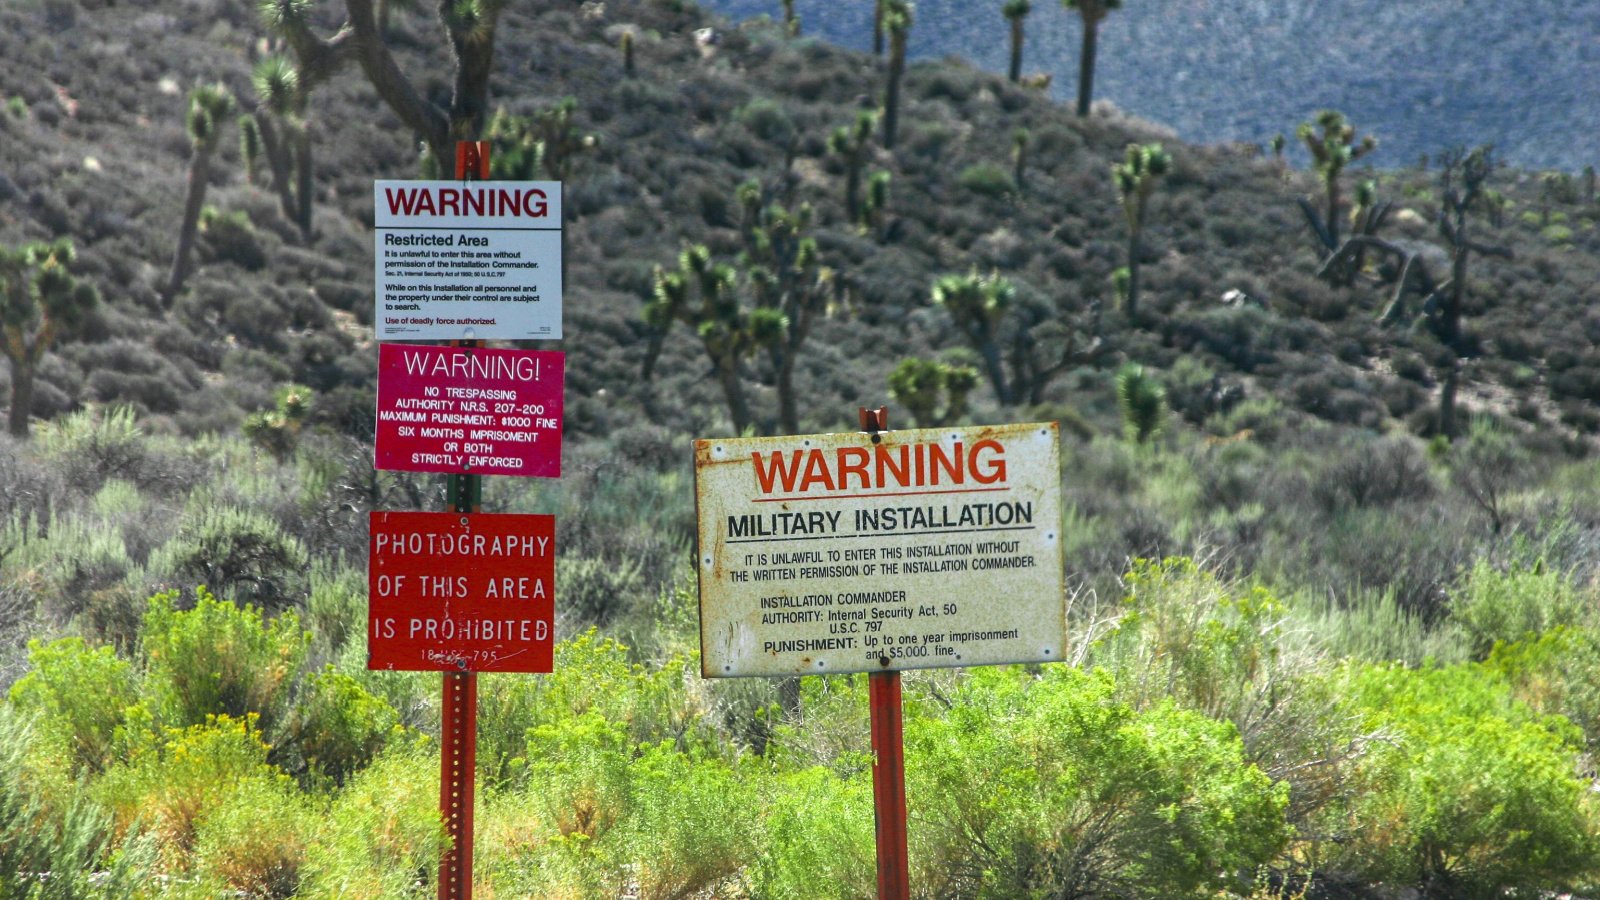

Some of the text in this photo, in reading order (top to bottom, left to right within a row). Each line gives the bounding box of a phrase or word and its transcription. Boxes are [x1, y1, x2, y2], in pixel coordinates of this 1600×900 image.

[385, 188, 547, 217] WARNING
[385, 234, 488, 246] Restricted Area
[513, 295, 539, 303] subject
[404, 351, 540, 381] WARNING!
[425, 387, 516, 400] NO TRESPASSING
[396, 399, 544, 414] AUTHORITY N.R.S. 207-200
[380, 411, 557, 429] MAXIMUM PUNISHMENT: $1000 FINE
[398, 426, 538, 442] SIX MONTHS IMPRISOMENT
[444, 442, 492, 453] OR BOTH
[412, 453, 522, 468] STRICTLY ENFORCED
[752, 439, 1007, 494] WARNING
[728, 502, 1032, 537] MILITARY INSTALLATION
[376, 533, 549, 557] PHOTOGRAPHY
[745, 541, 1020, 566] IT IS UNLAWFUL TO ENTER THIS INSTALLATION WITHOUT
[730, 556, 1037, 582] THE WRITTEN PERMISSION OF THE INSTALLATION COMMANDER.
[378, 575, 545, 599] OF THIS AREA
[761, 591, 906, 608] INSTALLATION COMMANDER
[762, 611, 824, 624] AUTHORITY:
[828, 608, 866, 621] Internal
[871, 607, 913, 621] Security
[943, 604, 957, 615] 50
[375, 618, 548, 641] IS PROHIBITED
[830, 621, 882, 634] U.S.C. 797
[764, 628, 1018, 653] PUNISHMENT: Up to one year imprisonment
[866, 644, 956, 660] and $5,000. fine.
